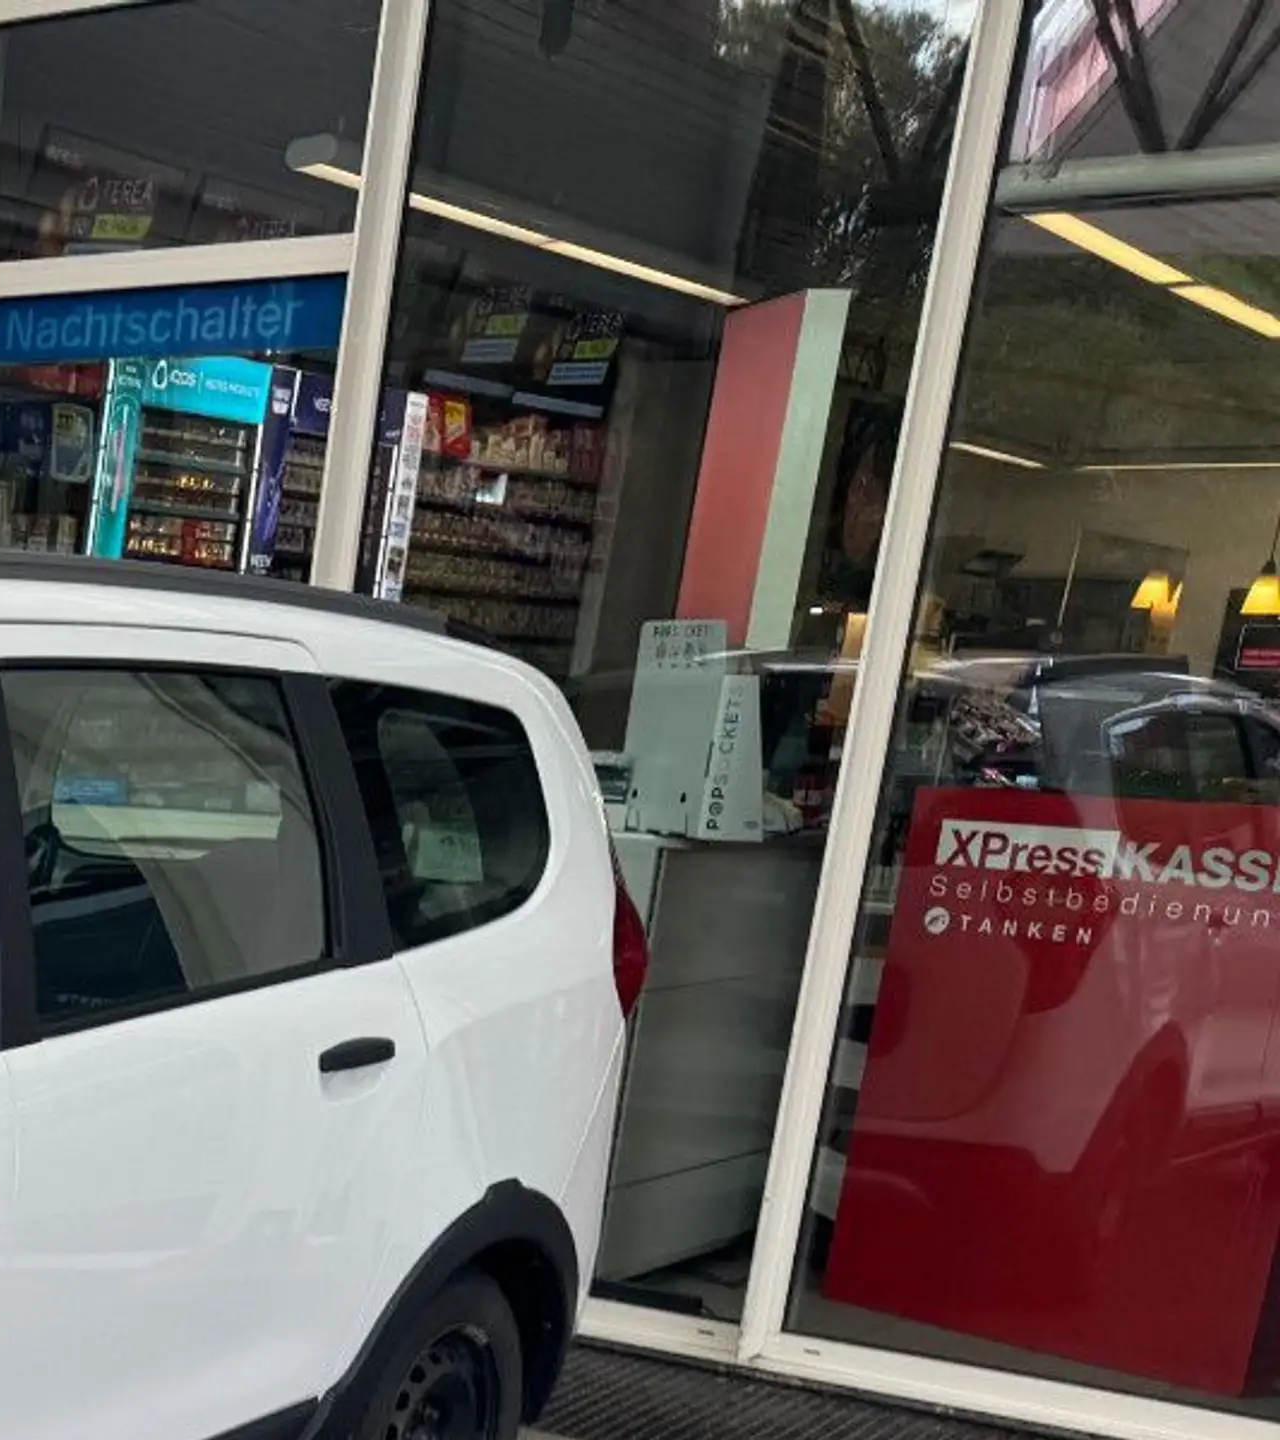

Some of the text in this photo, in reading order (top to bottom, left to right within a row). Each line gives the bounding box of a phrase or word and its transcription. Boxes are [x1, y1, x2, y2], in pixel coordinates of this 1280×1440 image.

[6, 293, 303, 351] Nachtschalter
[1116, 841, 1280, 893] KASS
[959, 914, 1093, 946] TANKEN
